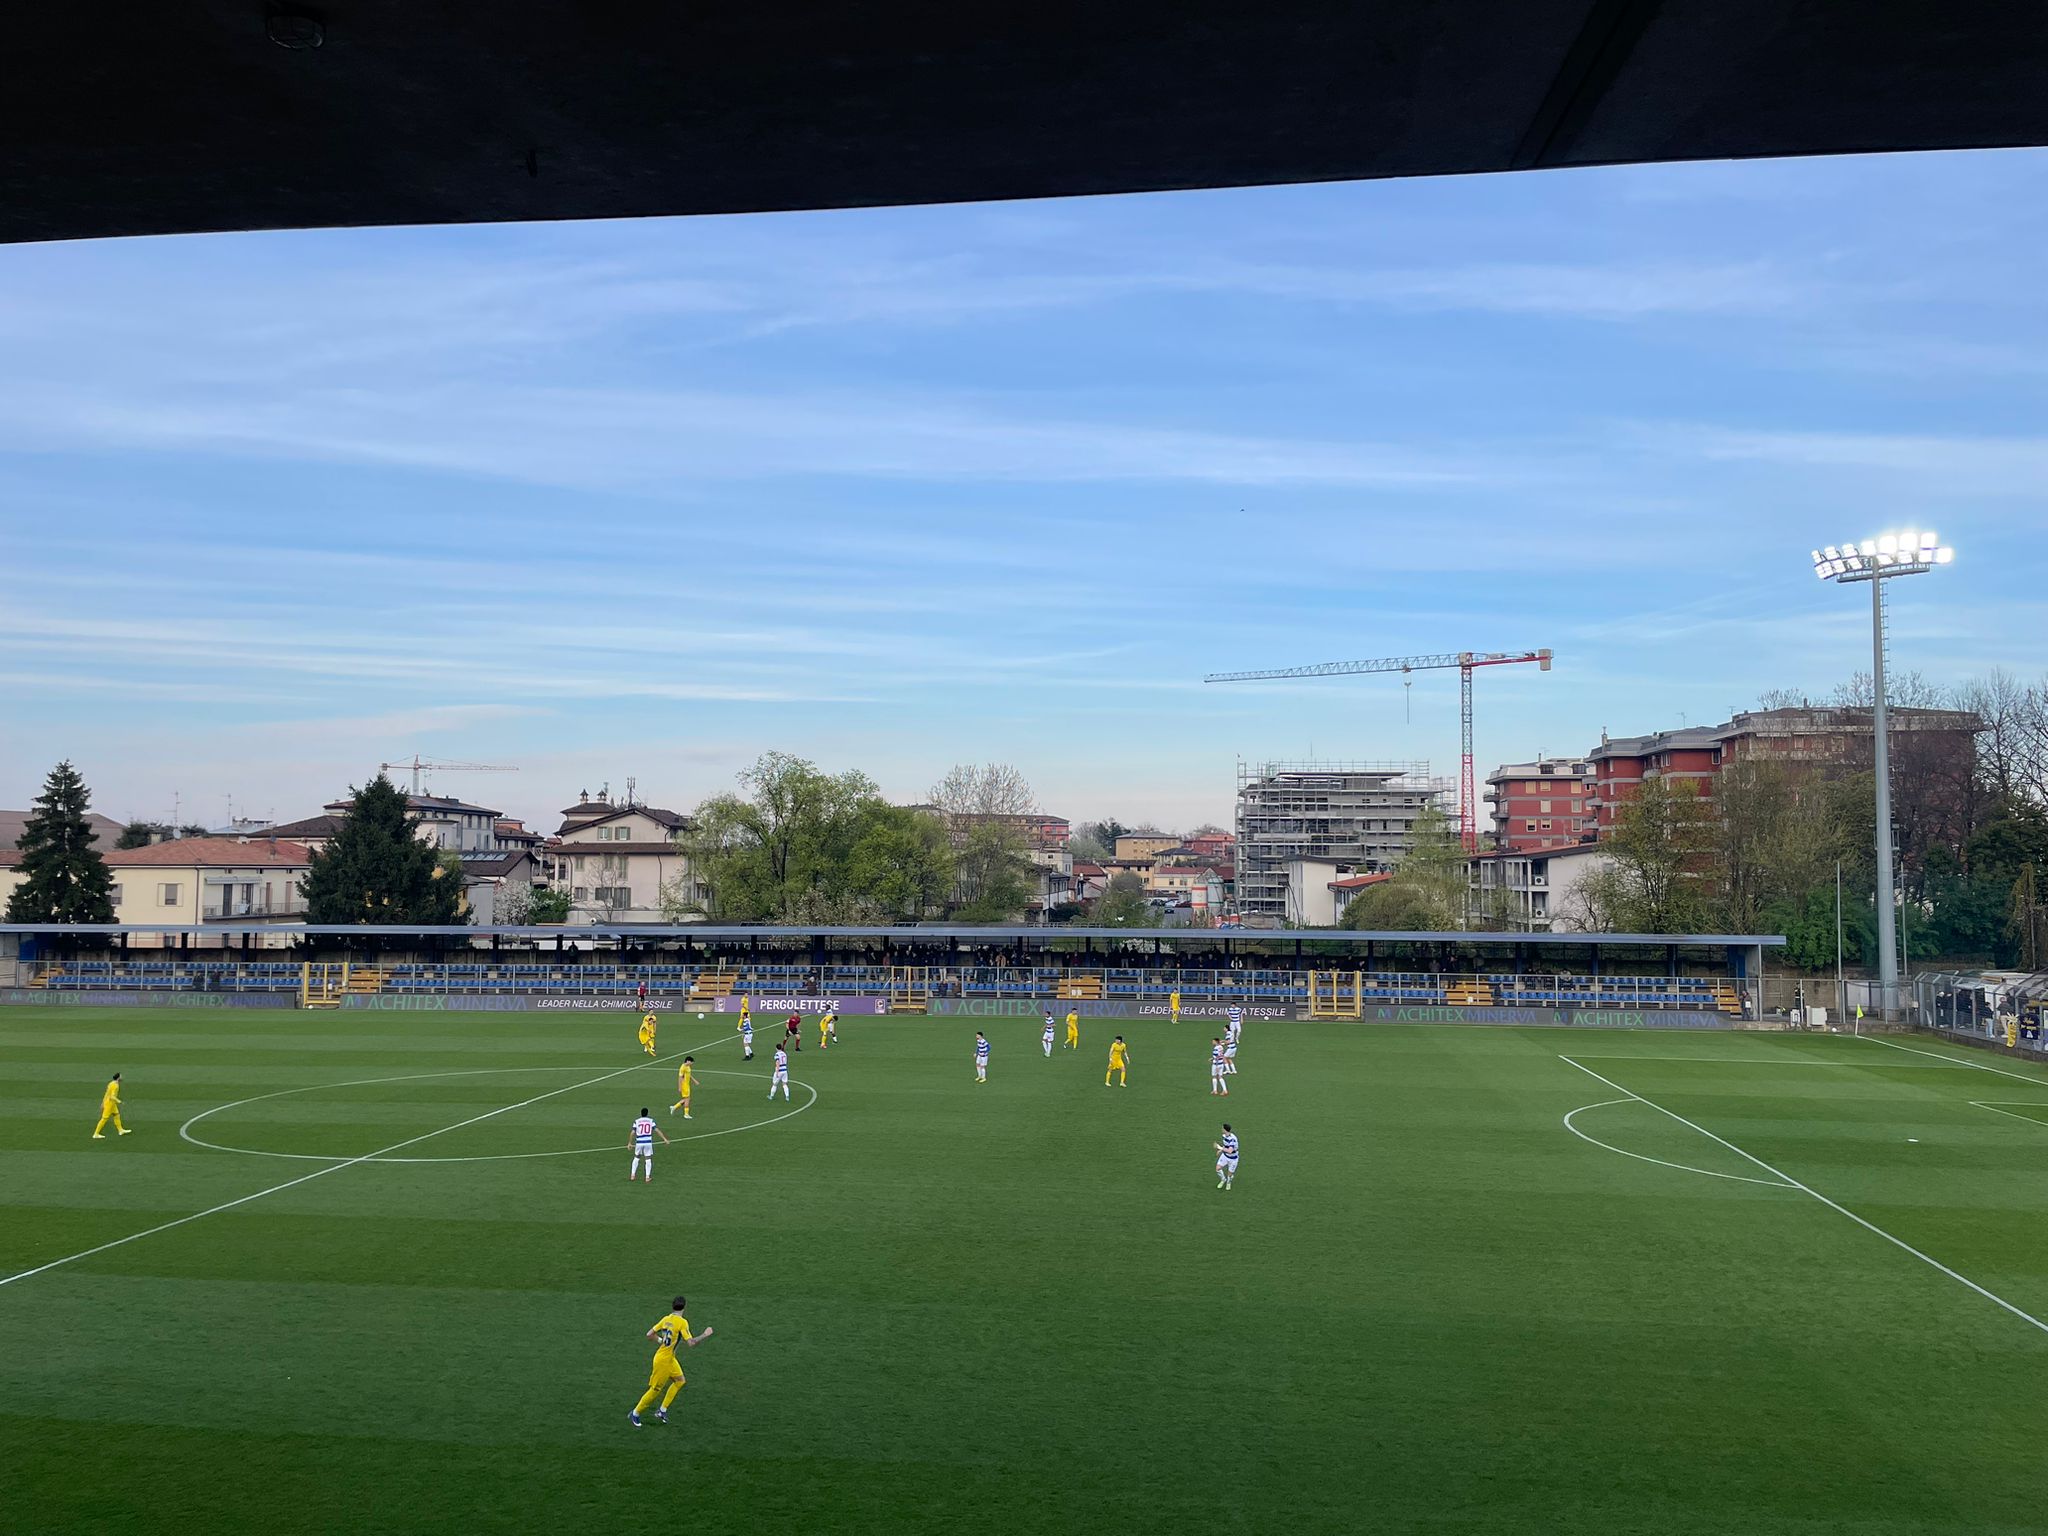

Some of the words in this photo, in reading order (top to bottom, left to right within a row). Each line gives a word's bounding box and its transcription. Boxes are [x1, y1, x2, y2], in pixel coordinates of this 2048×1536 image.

[27, 990, 80, 1004] ACHITEX
[167, 993, 225, 1007] ACHITEX
[367, 994, 445, 1011] ACHITEX
[448, 995, 527, 1012] MINERVA
[537, 999, 570, 1008] LEADER
[572, 1000, 599, 1009] NELLA
[601, 1000, 637, 1009] CHIMICA
[643, 1000, 673, 1009] ESSILE
[759, 999, 840, 1011] PERGOLETTESE
[957, 1000, 1040, 1016] ACHITEX
[1249, 1008, 1286, 1017] TESSILE
[1397, 1008, 1465, 1021] ACHITEX
[1466, 1010, 1537, 1023] MINERVA
[1573, 1011, 1645, 1026] ACHITEX
[1646, 1013, 1719, 1028] MINERVA
[638, 1123, 651, 1135] 70
